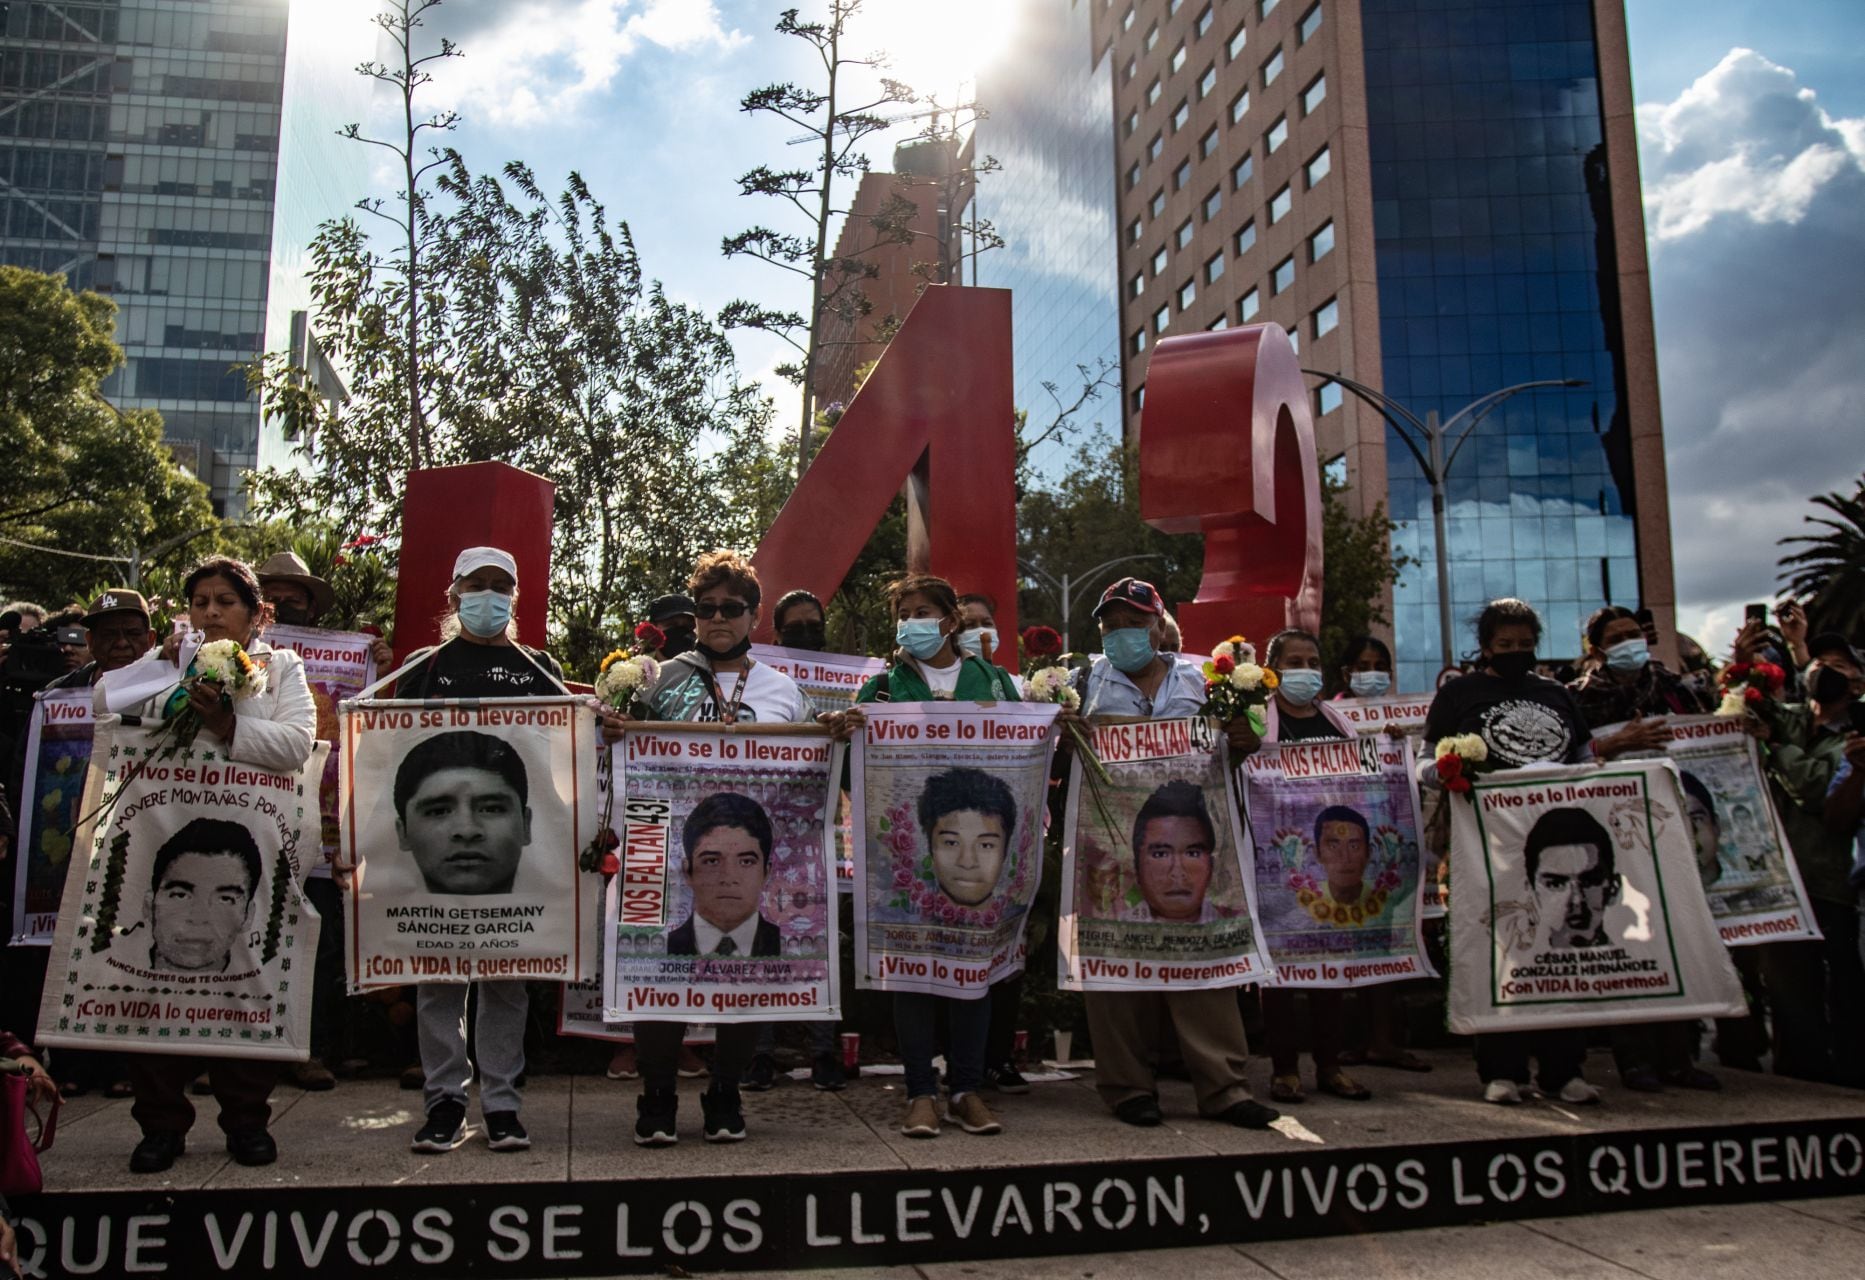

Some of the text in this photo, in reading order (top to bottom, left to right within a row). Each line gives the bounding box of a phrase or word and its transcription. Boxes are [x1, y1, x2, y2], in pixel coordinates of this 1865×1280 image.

[795, 664, 808, 679] lo
[815, 666, 870, 685] llevaro
[45, 703, 87, 724] ¡Vivo
[355, 707, 568, 733] ¡Vivo se lo llevaron!
[1364, 707, 1379, 721] lo
[1384, 704, 1430, 719] llevar
[867, 719, 1050, 745] ¡Vivo se lo llevaro
[1098, 726, 1131, 760] NOS
[1135, 721, 1191, 758] FALTAN
[628, 735, 831, 763] ¡Vivo se lo llevaron!
[1281, 745, 1309, 776] NOS
[1311, 741, 1361, 774] FALTAN
[1359, 737, 1382, 773] 43!
[174, 767, 196, 783] se
[200, 764, 220, 785] lo
[224, 766, 295, 792] llevaron!
[115, 789, 168, 831] MOVERE
[171, 787, 250, 807] MONTAÑAS
[254, 796, 277, 818] POR
[1483, 781, 1638, 812] ¡Vivo se lo llevaron!
[624, 823, 666, 885] FALTAN
[386, 904, 545, 920] MARTÍN GETSEMANY
[622, 888, 663, 924] NOS
[397, 920, 535, 936] SÁNCHEZ GARCÍA
[1720, 915, 1800, 940] queremos!
[416, 938, 519, 950] EDAD 20 AÑOS
[1580, 949, 1630, 962] MANUEL
[106, 957, 262, 984] NUNCA ESPERES QUE TE OLVIDEMOS
[366, 954, 568, 978] ¡Con VIDA lo queremos!
[658, 963, 697, 974] JORGE
[763, 964, 793, 975] NAVA
[879, 956, 927, 977] ¡Vivo
[933, 960, 948, 979] lo
[1081, 957, 1252, 982] ¡Vivo lo queremos!
[1276, 956, 1416, 984] ¡Vivo lo queremos!
[1502, 972, 1669, 998] ¡Con VIDA lo queremos!
[77, 1000, 271, 1024] ¡Con VIDA lo queremos!
[627, 987, 679, 1010] ¡Vivo
[686, 988, 705, 1007] lo
[711, 987, 818, 1012] queremos!
[10, 1131, 1864, 1279] QUE VIVOS SE LOS LLEVARON, VIVOS LOS QUEREMO
